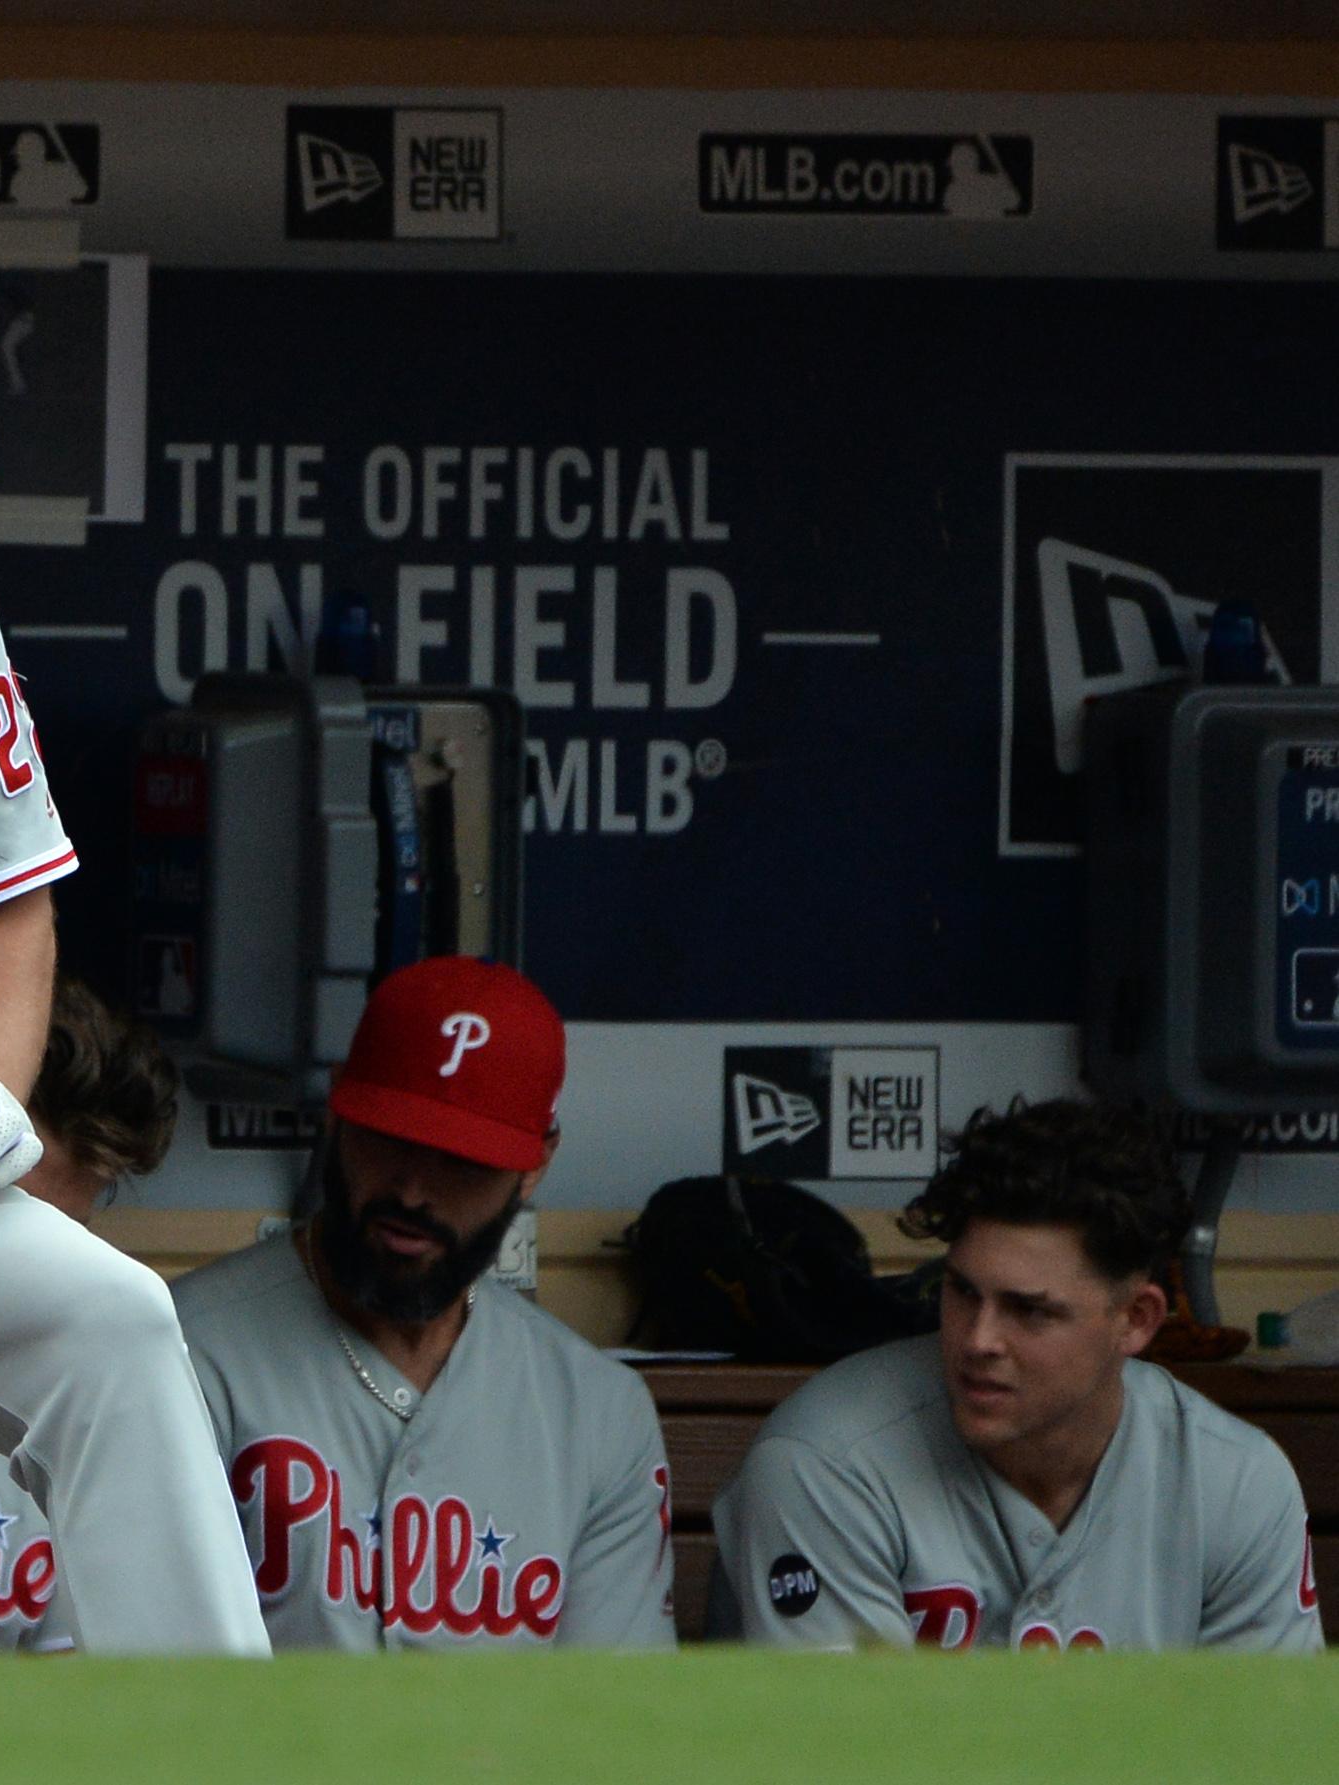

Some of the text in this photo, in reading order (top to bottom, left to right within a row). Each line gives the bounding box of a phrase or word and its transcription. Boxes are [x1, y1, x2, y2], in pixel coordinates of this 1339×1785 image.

[410, 137, 487, 174] NEW
[709, 145, 938, 203] MLB.com
[410, 176, 487, 212] ERA
[164, 442, 731, 542] THE OFFICIAL
[154, 559, 739, 711] ON FIELD
[439, 1011, 491, 1078] P
[848, 1075, 923, 1112] NEW
[848, 1115, 923, 1151] ERA
[230, 1434, 566, 1641] Phillie
